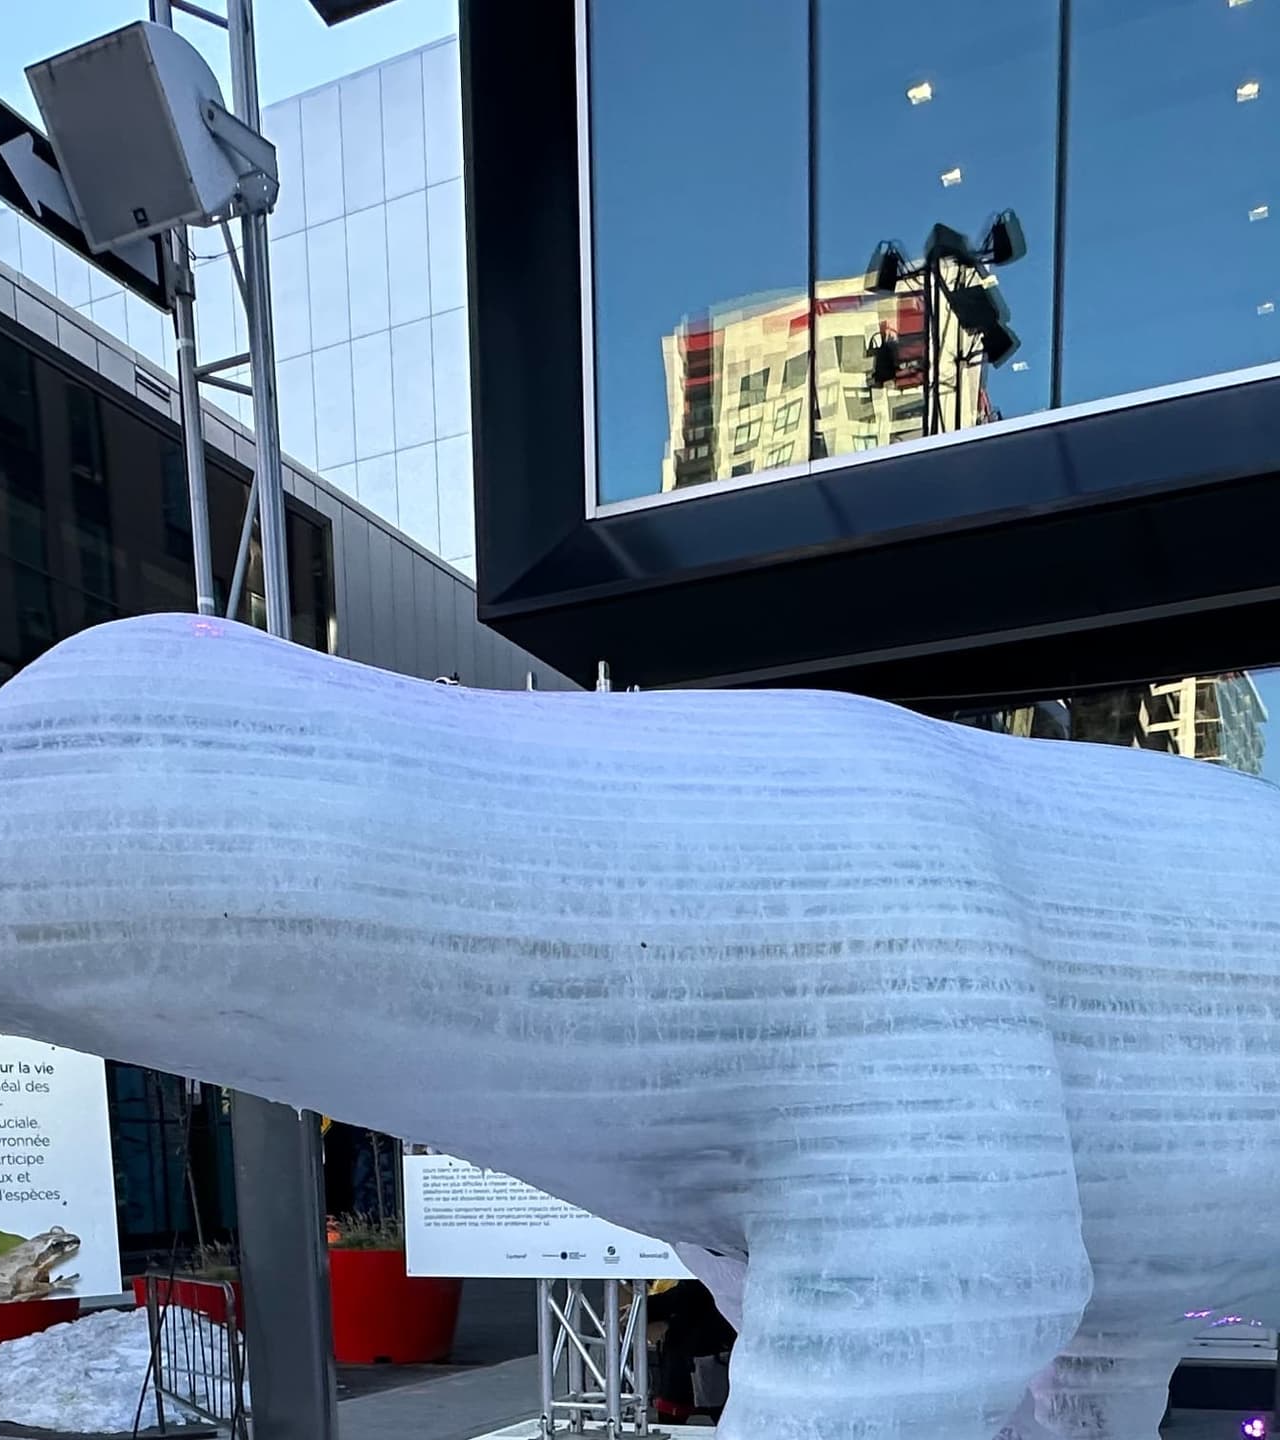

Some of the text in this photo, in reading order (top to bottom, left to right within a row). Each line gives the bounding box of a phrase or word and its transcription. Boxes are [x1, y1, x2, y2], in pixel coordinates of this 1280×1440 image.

[19, 1061, 30, 1074] la
[34, 1062, 54, 1075] vie
[25, 1080, 50, 1093] des
[17, 1171, 31, 1184] et
